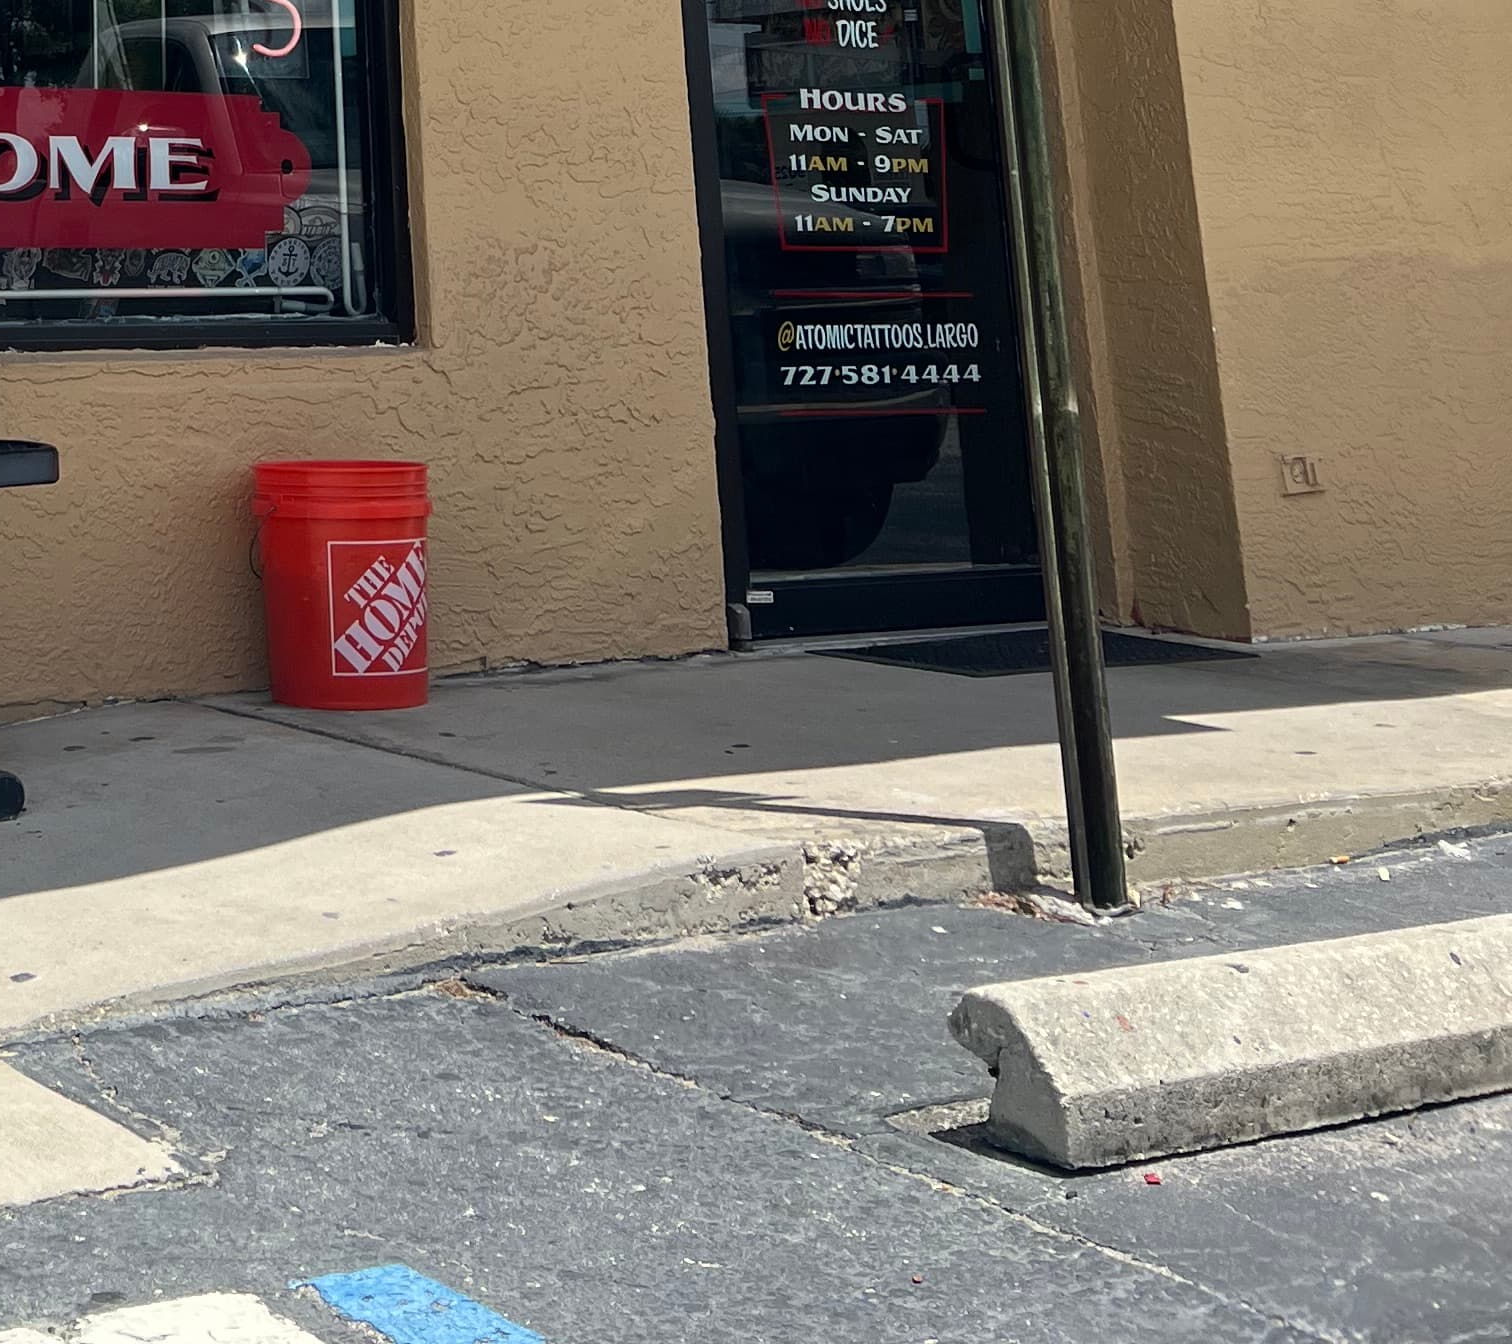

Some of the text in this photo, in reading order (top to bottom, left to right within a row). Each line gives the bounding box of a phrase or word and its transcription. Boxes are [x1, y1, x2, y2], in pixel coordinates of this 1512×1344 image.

[803, 17, 880, 49] NO DICE
[799, 88, 908, 113] HOURS
[789, 123, 849, 143] MON
[875, 125, 923, 145] SAT
[788, 154, 848, 173] 11AM
[873, 154, 929, 174] 9PM
[810, 183, 912, 204] SUNDAY
[794, 215, 854, 233] 11AM
[881, 216, 934, 234] 7PM
[343, 554, 396, 609] THE
